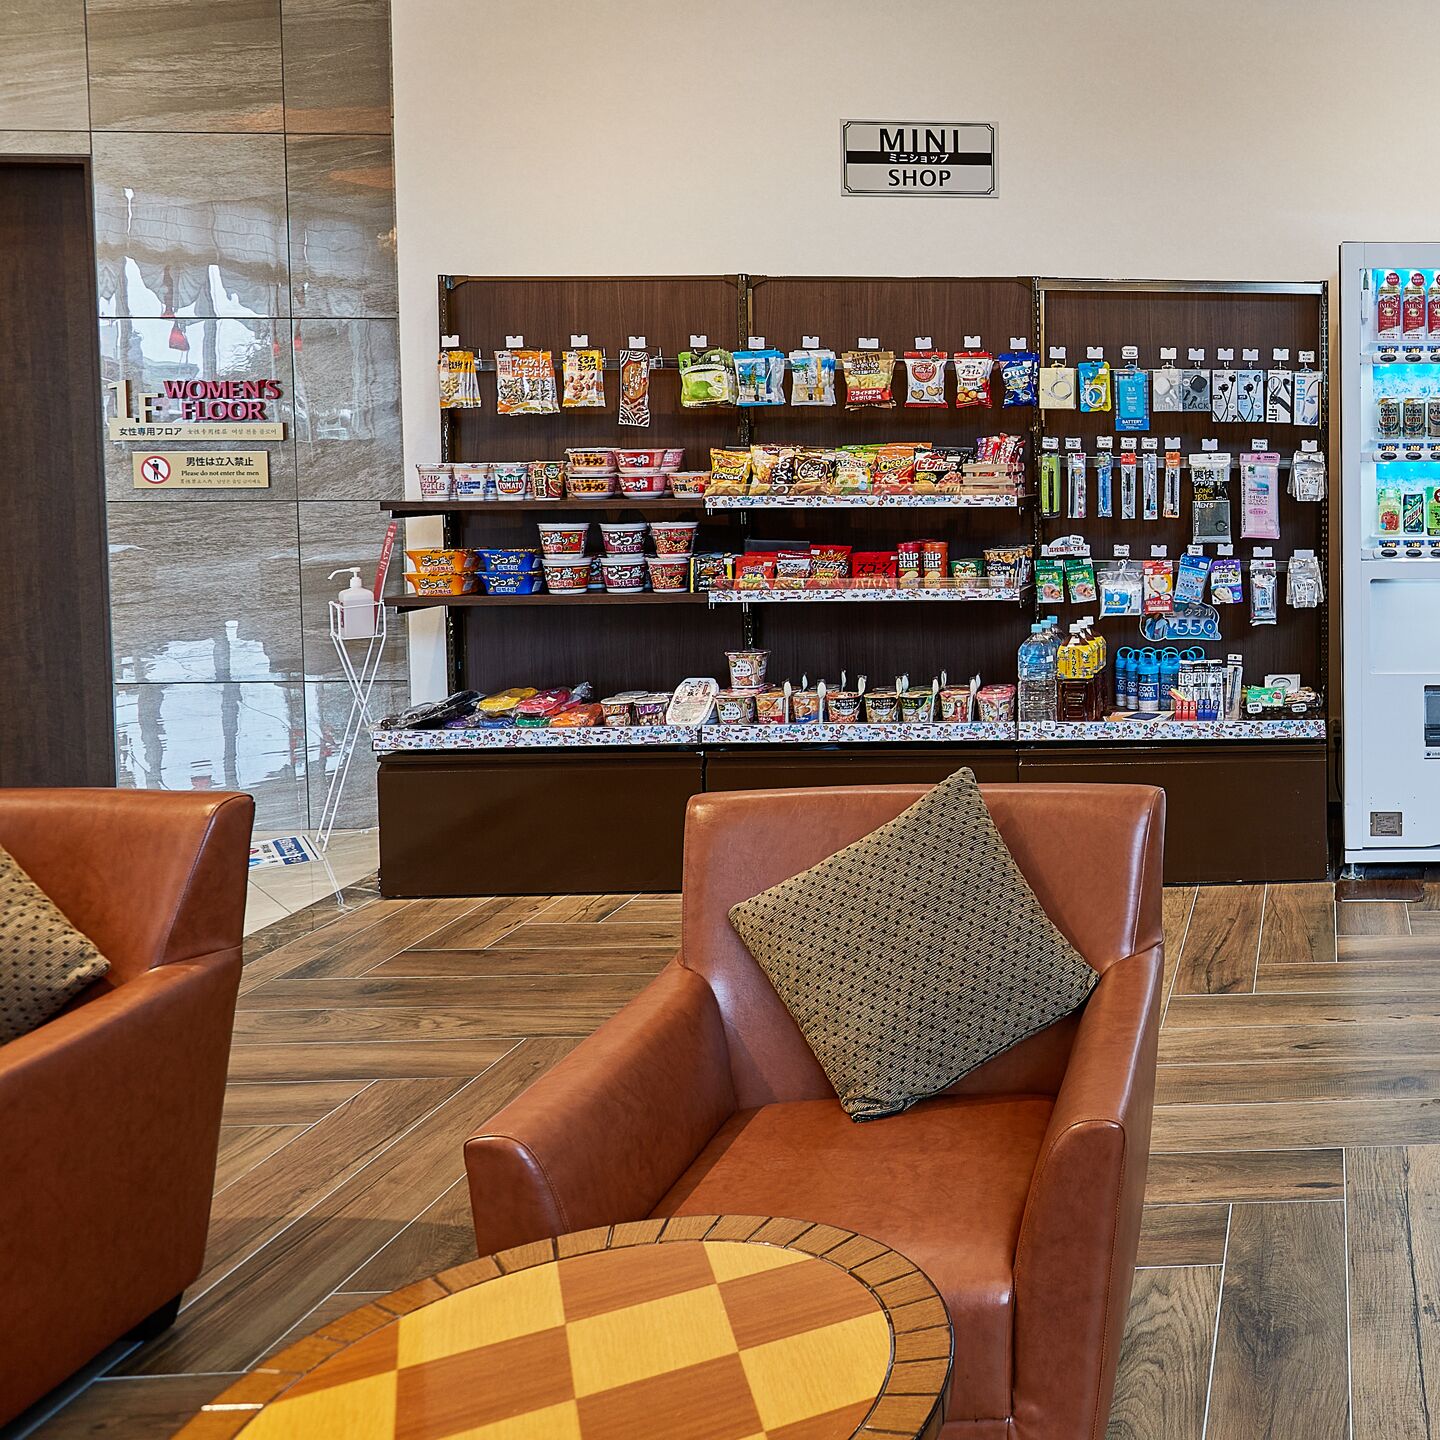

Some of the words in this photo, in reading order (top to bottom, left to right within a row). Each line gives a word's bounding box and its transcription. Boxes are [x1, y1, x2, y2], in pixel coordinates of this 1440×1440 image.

[879, 128, 960, 153] MINI
[888, 153, 950, 164] ミニショップ
[888, 169, 951, 186] SHOP
[577, 355, 596, 364] くるみ
[577, 363, 597, 371] ミックス
[163, 380, 282, 400] WOMEN'S
[182, 401, 267, 420] FLOOR
[1182, 402, 1209, 410] BLACK
[119, 427, 182, 436] 女性専用フロア
[186, 457, 254, 467] 男性は立入禁止
[1193, 470, 1215, 480] 爽快
[498, 481, 523, 489] TOMATO
[1193, 486, 1214, 494] LONG
[898, 551, 919, 560] chip
[856, 562, 893, 574] スコーン
[898, 559, 919, 568] star
[1184, 608, 1214, 617] タオル
